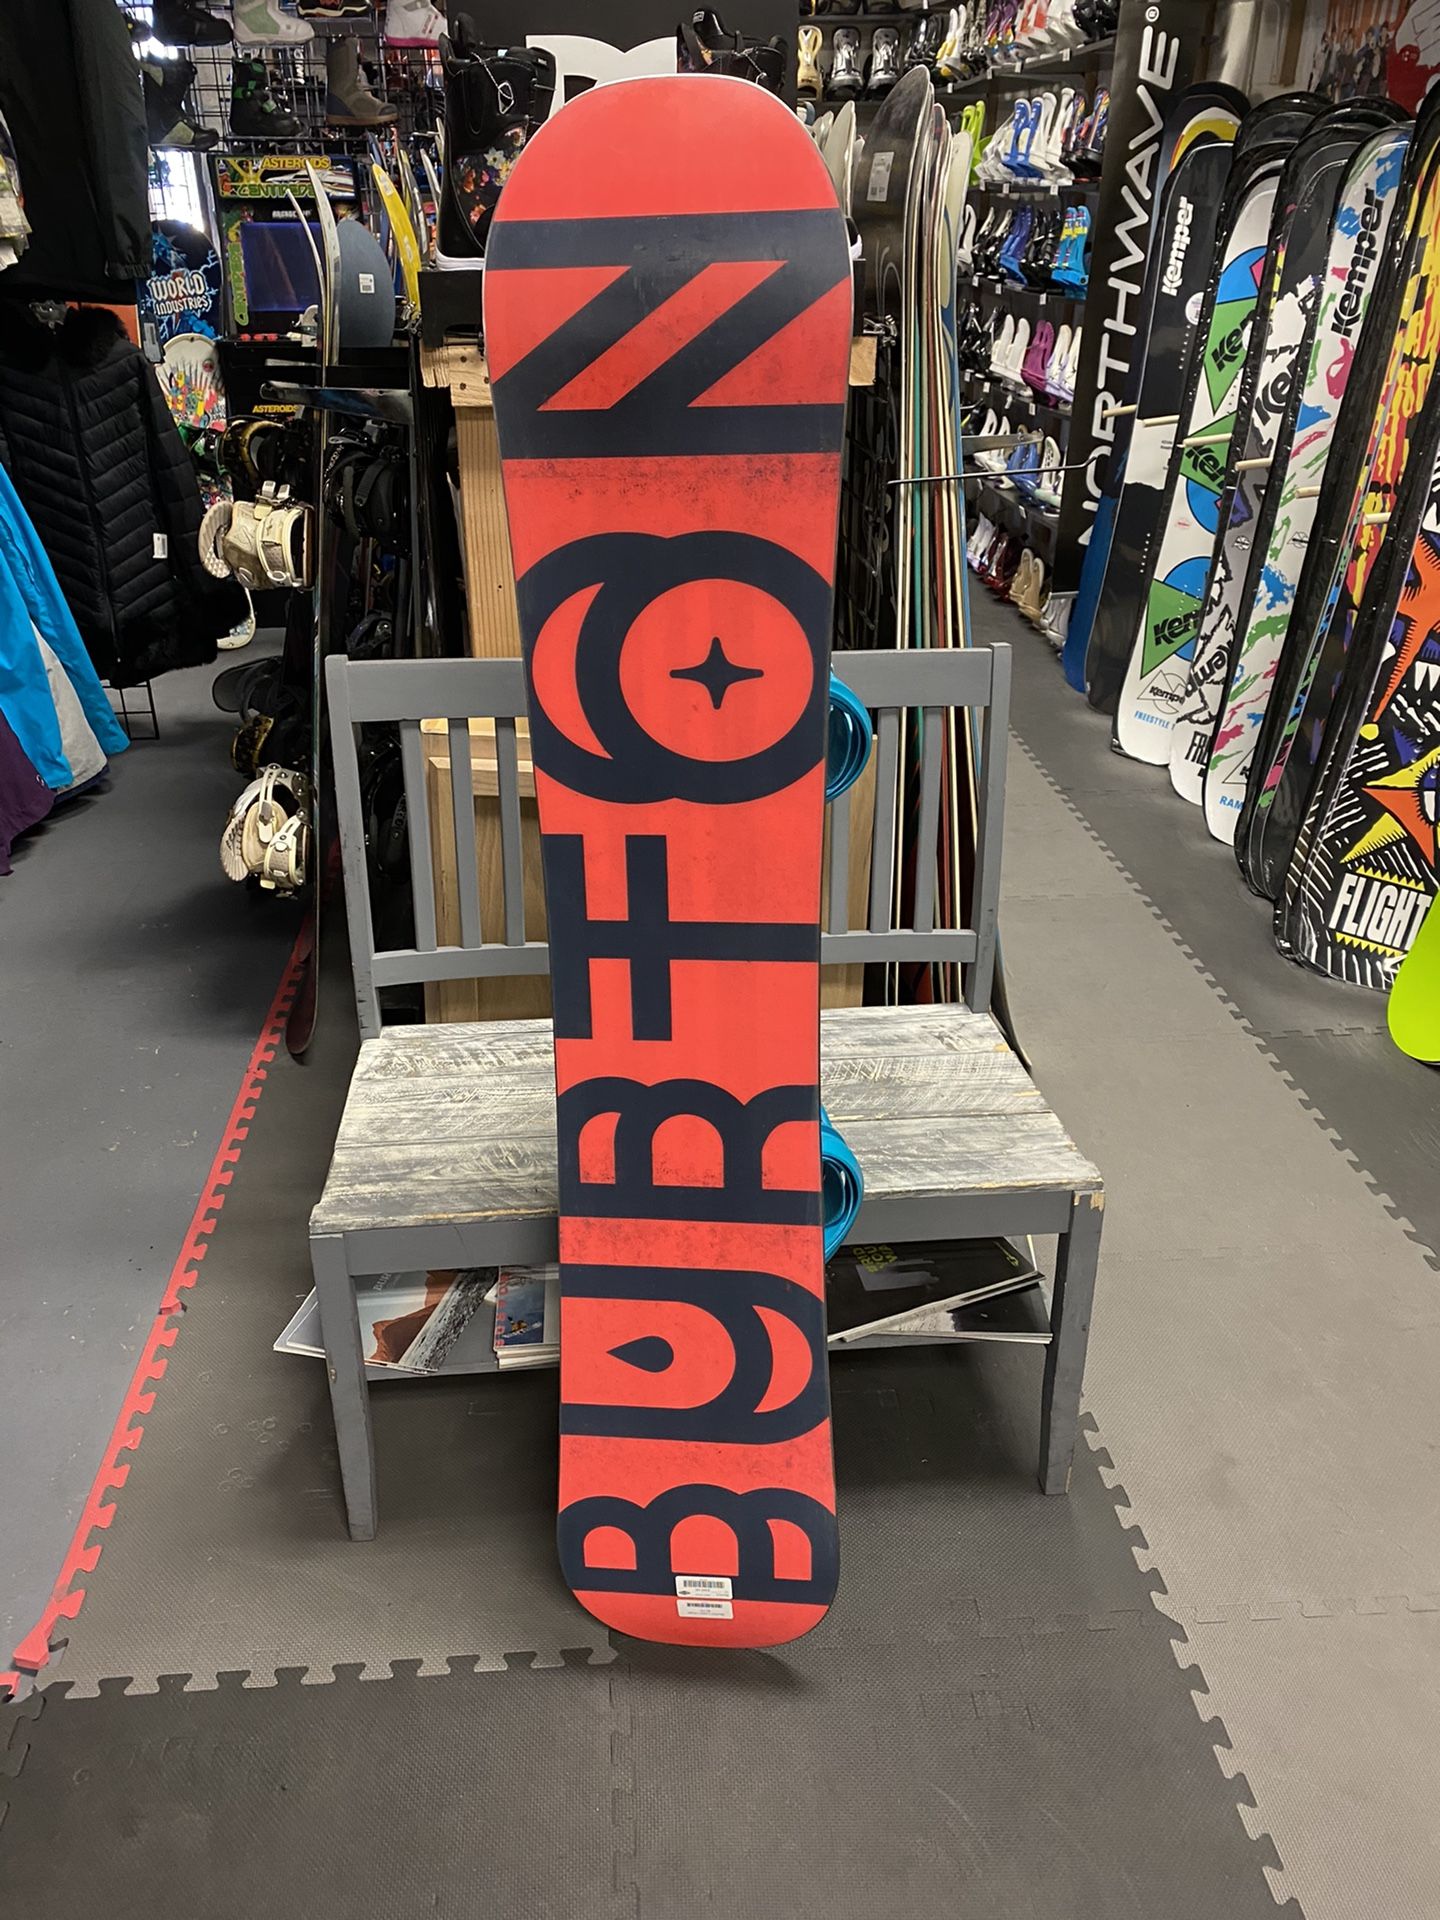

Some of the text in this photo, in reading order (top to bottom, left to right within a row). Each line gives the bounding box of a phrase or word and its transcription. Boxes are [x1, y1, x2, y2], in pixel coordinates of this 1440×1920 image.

[261, 156, 330, 169] ASTERODS
[1161, 196, 1194, 296] Kemper
[1331, 186, 1384, 338] Kemper
[149, 271, 206, 300] WORLD
[1134, 710, 1170, 730] FREESTYLE
[484, 209, 853, 1605] BURTON
[1328, 873, 1433, 951] FLIGHT
